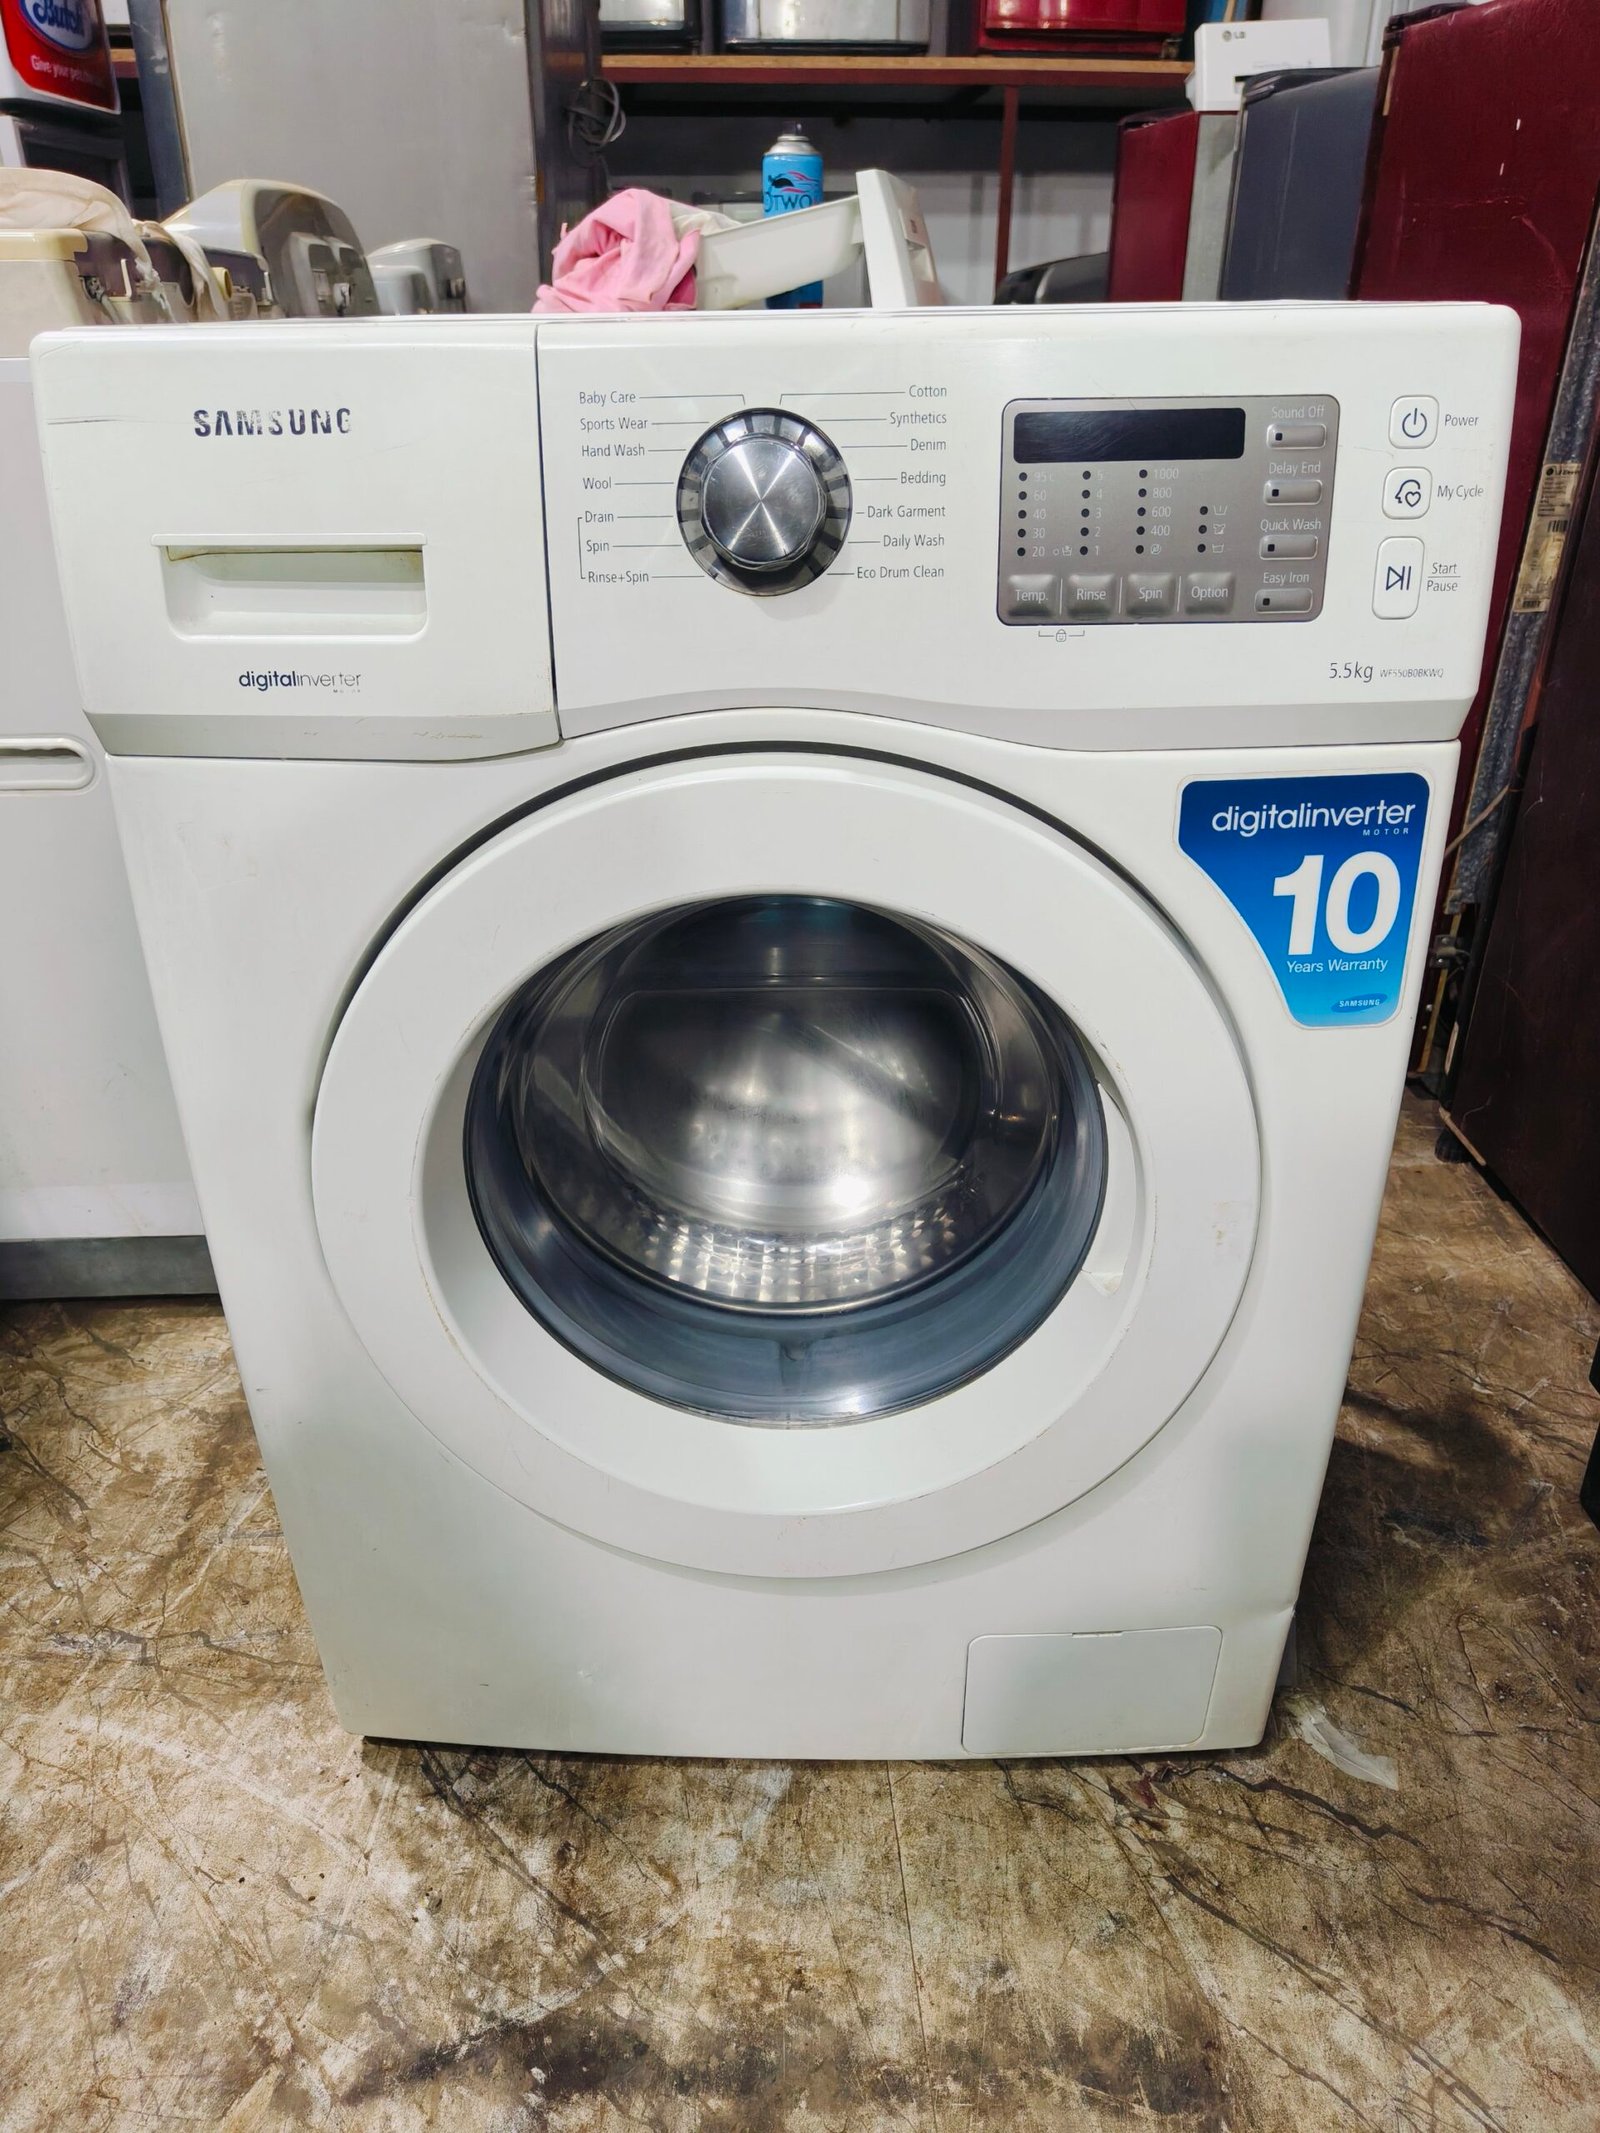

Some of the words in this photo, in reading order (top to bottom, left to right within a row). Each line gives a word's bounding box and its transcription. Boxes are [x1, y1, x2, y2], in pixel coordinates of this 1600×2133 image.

[908, 385, 947, 398] Cotton
[579, 391, 607, 407] Baby
[610, 391, 636, 404] Care
[1271, 406, 1305, 419] Sound
[1308, 405, 1325, 418] Off
[193, 407, 352, 437] SAMSUNG
[580, 418, 615, 432] Sports
[618, 417, 648, 430] Wear
[889, 411, 947, 428] Synthetics
[1445, 414, 1479, 427] Power
[581, 444, 611, 457] Hand
[614, 443, 645, 456] Wash
[910, 438, 947, 451] Denim
[1269, 462, 1298, 477] Delay
[1301, 461, 1321, 474] End
[583, 477, 612, 490] Wool
[900, 471, 946, 486] Bedding
[1033, 490, 1046, 501] 60
[1096, 488, 1103, 500] 4
[1153, 487, 1172, 499] 800
[1437, 484, 1454, 500] My
[1456, 485, 1484, 501] Cycle
[585, 511, 614, 523] Drain
[867, 505, 893, 518] Dark
[897, 505, 946, 517] Garment
[1033, 509, 1046, 520] 40
[1095, 507, 1102, 519] 3
[1151, 506, 1171, 518] 600
[1094, 526, 1101, 538] 2
[1150, 525, 1170, 537] 400
[1260, 519, 1289, 533] Quick
[1292, 518, 1321, 531] Wash
[1032, 528, 1046, 539] 30
[586, 540, 609, 555] Spin
[883, 535, 910, 550] Daily
[914, 534, 945, 546] Wash
[1031, 547, 1045, 558] 20
[857, 567, 876, 579] Eco
[879, 566, 910, 578] Drum
[913, 565, 944, 578] Clean
[1431, 562, 1457, 574] Start
[588, 570, 649, 585] Rinse+Spin
[1263, 572, 1286, 587] Easy
[1289, 571, 1310, 584] Iron
[1191, 585, 1229, 601] Option
[1427, 580, 1458, 592] Pause
[1015, 588, 1049, 603] Temp.
[1076, 587, 1107, 600] Rinse
[1139, 586, 1163, 602] Spin
[1329, 661, 1374, 683] 5.5kg
[239, 670, 361, 691] digitalinverter
[1211, 799, 1416, 837] digitalinverter
[1362, 828, 1409, 836] MOTOR
[1273, 851, 1401, 956] 10
[1286, 960, 1324, 974] Years
[1327, 957, 1388, 973] Warranty
[1339, 998, 1380, 1008] SAMSUNG
